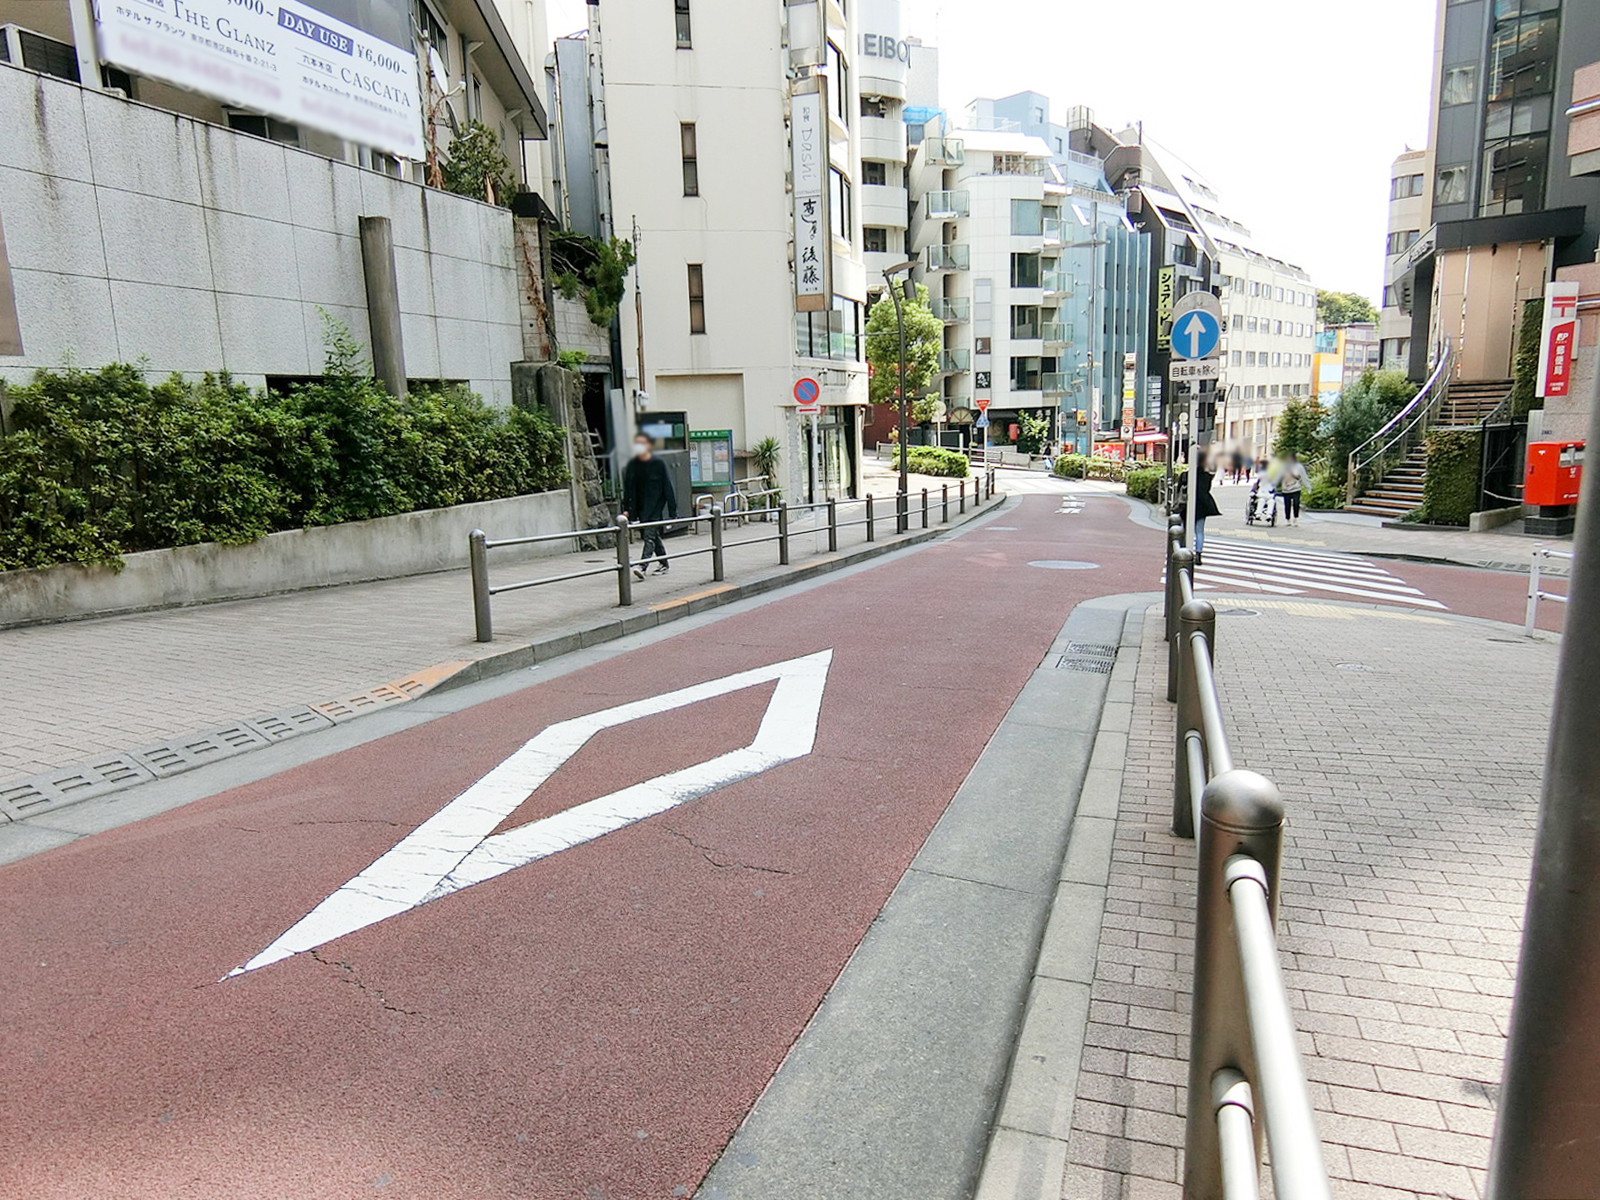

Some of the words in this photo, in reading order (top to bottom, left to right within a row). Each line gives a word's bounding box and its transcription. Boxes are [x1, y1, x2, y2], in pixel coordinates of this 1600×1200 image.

[116, 6, 141, 21] ホテル
[216, 17, 276, 56] GLANZ
[284, 13, 315, 37] DAY
[319, 28, 349, 53] USE
[302, 55, 333, 74] 六本木店
[341, 67, 411, 107] CASCATA
[1172, 364, 1216, 378] 自転車を除く
